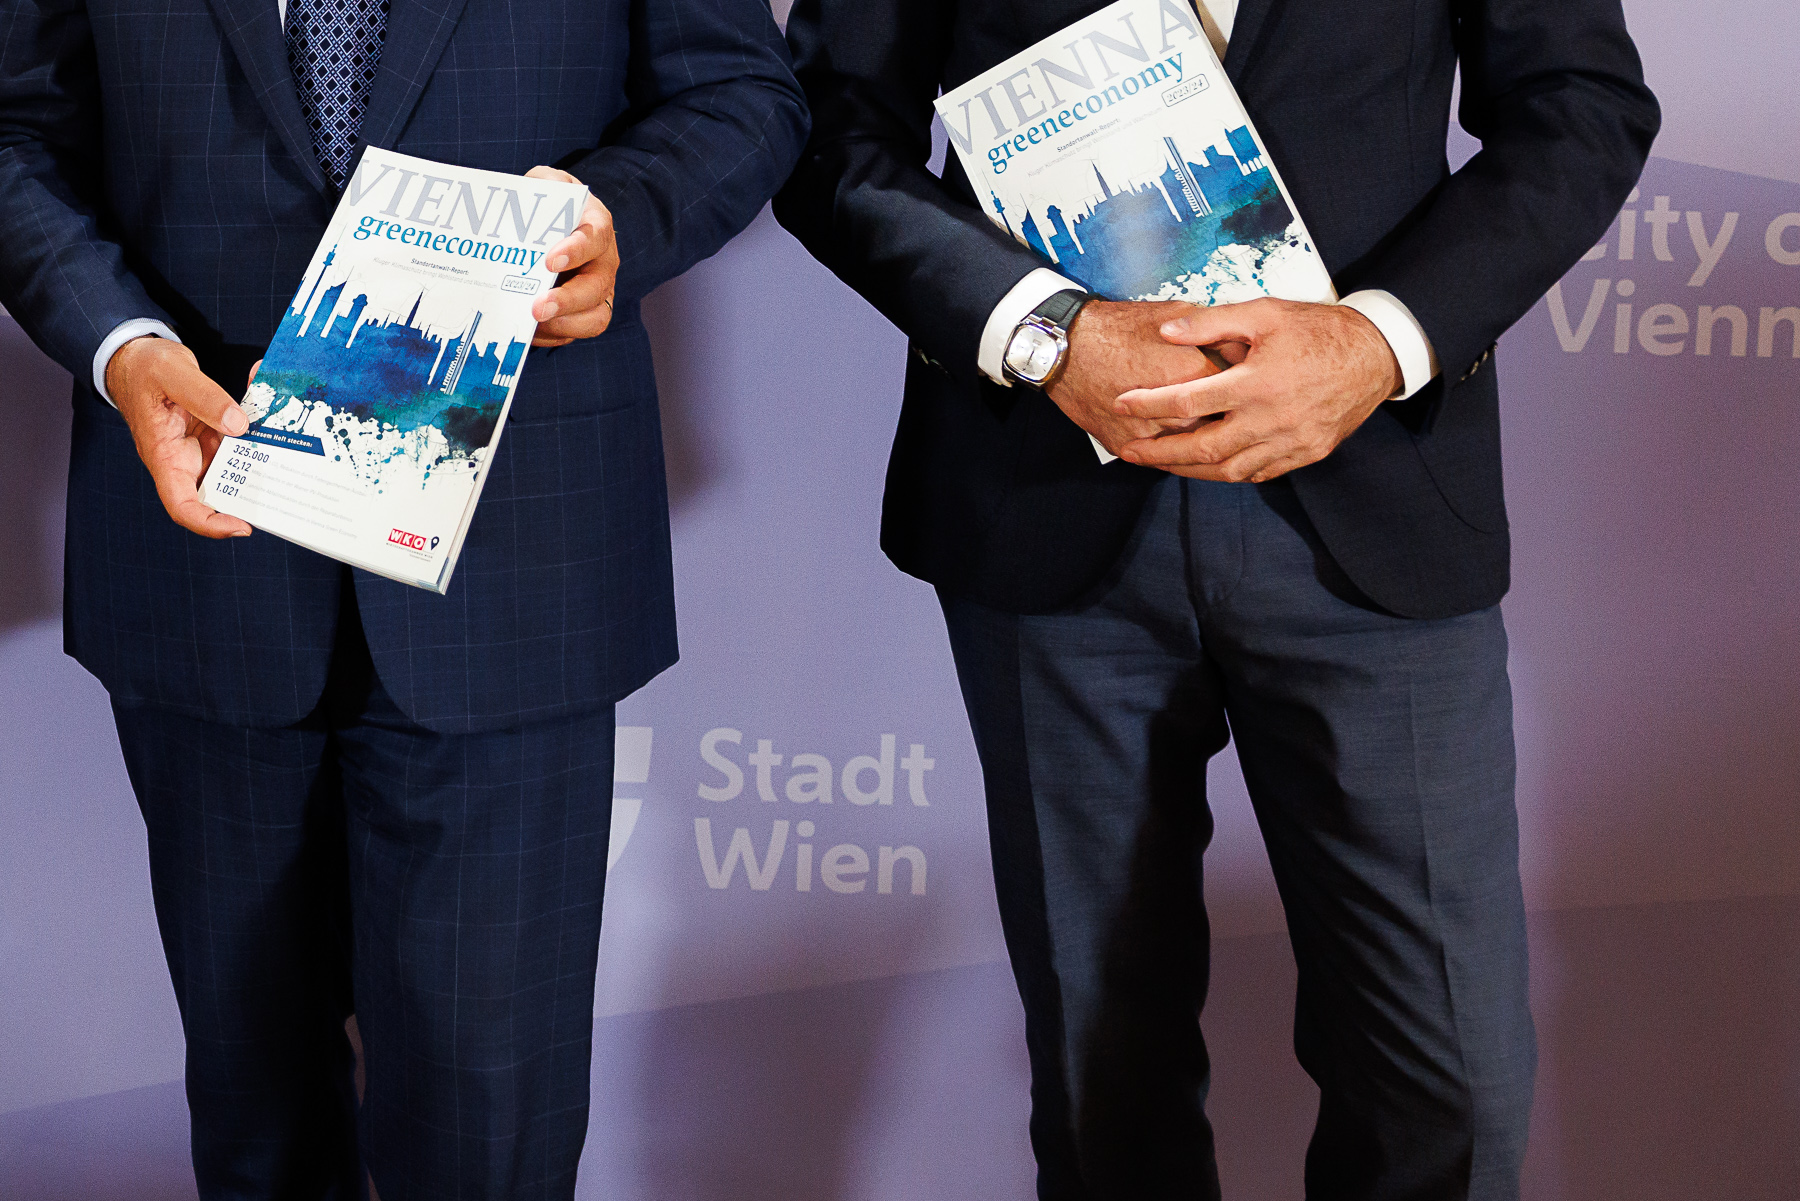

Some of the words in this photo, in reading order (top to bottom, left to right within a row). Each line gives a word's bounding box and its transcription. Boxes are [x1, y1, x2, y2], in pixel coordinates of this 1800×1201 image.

[1166, 78, 1204, 103] 2023/24
[987, 52, 1184, 175] greeneconomy
[350, 159, 575, 246] VIENNA
[353, 215, 545, 276] greeneconomy
[504, 278, 537, 292] 2023/24
[1545, 278, 1800, 358] Vienn
[226, 457, 252, 472] 42,12
[233, 444, 270, 463] 325.000
[220, 469, 247, 485] 2.900
[216, 482, 240, 498] 1.021
[390, 529, 425, 549] WKO
[697, 727, 936, 807] Stadt
[694, 817, 928, 897] Wien
